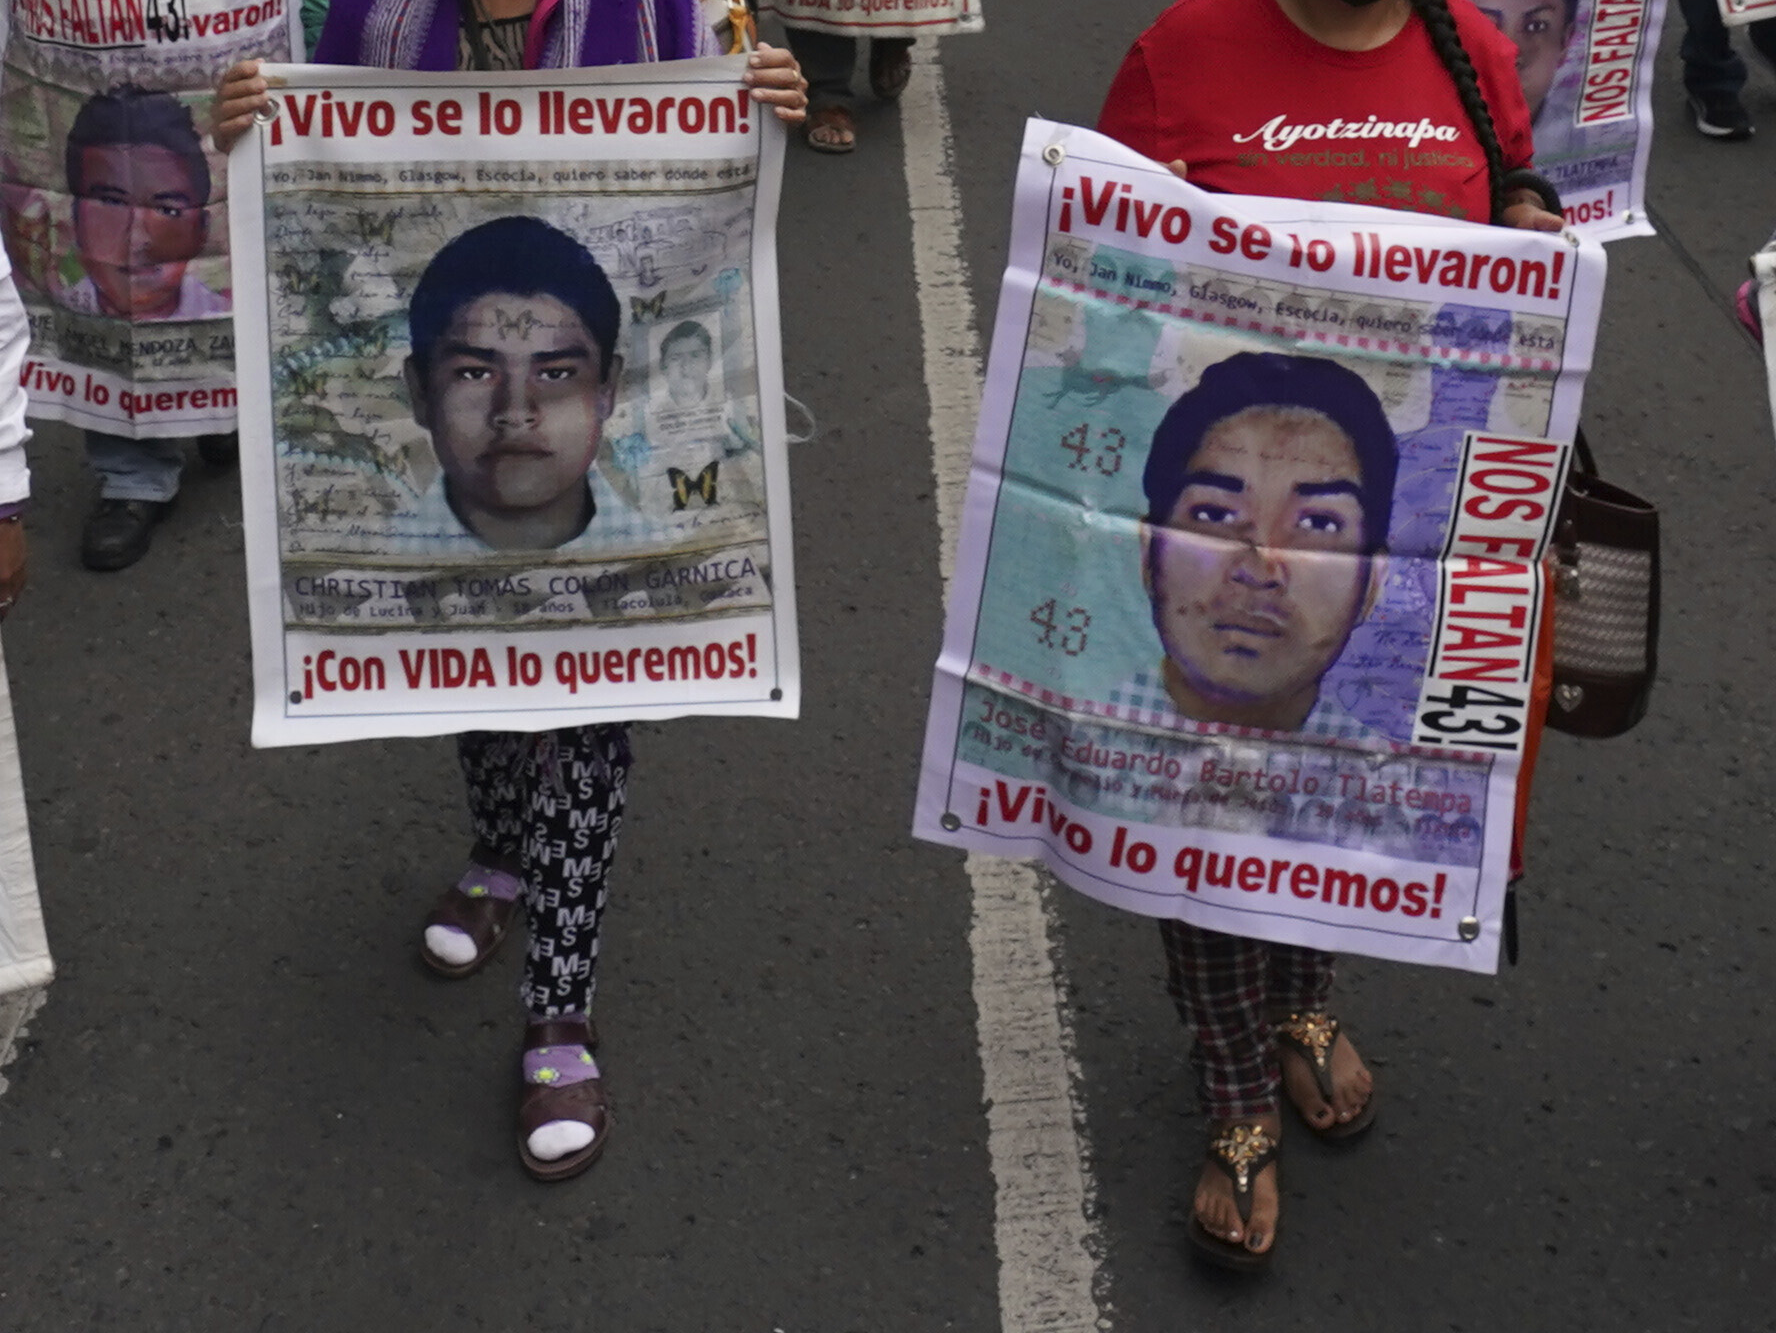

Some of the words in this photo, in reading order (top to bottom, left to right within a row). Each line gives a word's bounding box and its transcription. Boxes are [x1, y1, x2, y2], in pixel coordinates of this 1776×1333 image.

[269, 90, 396, 146] ¡Vivo
[411, 98, 463, 135] se
[478, 91, 522, 135] lo
[538, 88, 751, 135] llevaron!
[1583, 70, 1631, 124] NOS
[1232, 114, 1461, 152] Ayotzinapa
[1237, 150, 1268, 169] sin
[1378, 147, 1397, 168] ni
[1402, 147, 1475, 171] justicia
[307, 168, 332, 183] Jan
[399, 167, 465, 187] Glasgow,
[476, 168, 544, 185] Escocia,
[553, 167, 605, 186] quiero
[614, 166, 656, 182] saber
[1059, 176, 1192, 245] ¡Vivo
[1208, 215, 1272, 262] se
[1288, 233, 1336, 273] lo
[1353, 231, 1566, 301] llevaron!
[1089, 261, 1118, 283] Jan
[1189, 284, 1264, 316] Glasgow,
[1059, 421, 1129, 479] 43
[1463, 436, 1566, 523] NOS
[294, 575, 436, 601] CHRISTIAN
[455, 573, 531, 598] TOMÁS
[549, 568, 629, 596] COLÓN
[645, 557, 757, 591] GARNICA
[1437, 531, 1546, 685] FALTAN
[1028, 597, 1094, 660] 43
[304, 648, 386, 700] ¡Con
[399, 645, 496, 690] VIDA
[507, 644, 542, 686] lo
[555, 633, 759, 695] queremos!
[1417, 680, 1532, 753] 43!
[980, 700, 1047, 741] José
[1061, 737, 1182, 781] Eduardo
[1199, 761, 1320, 797] Bartolo
[1337, 773, 1474, 816] Tlatempa
[977, 779, 1094, 856] ¡Vivo
[1109, 826, 1158, 875] lo
[1173, 844, 1448, 920] queremos!
